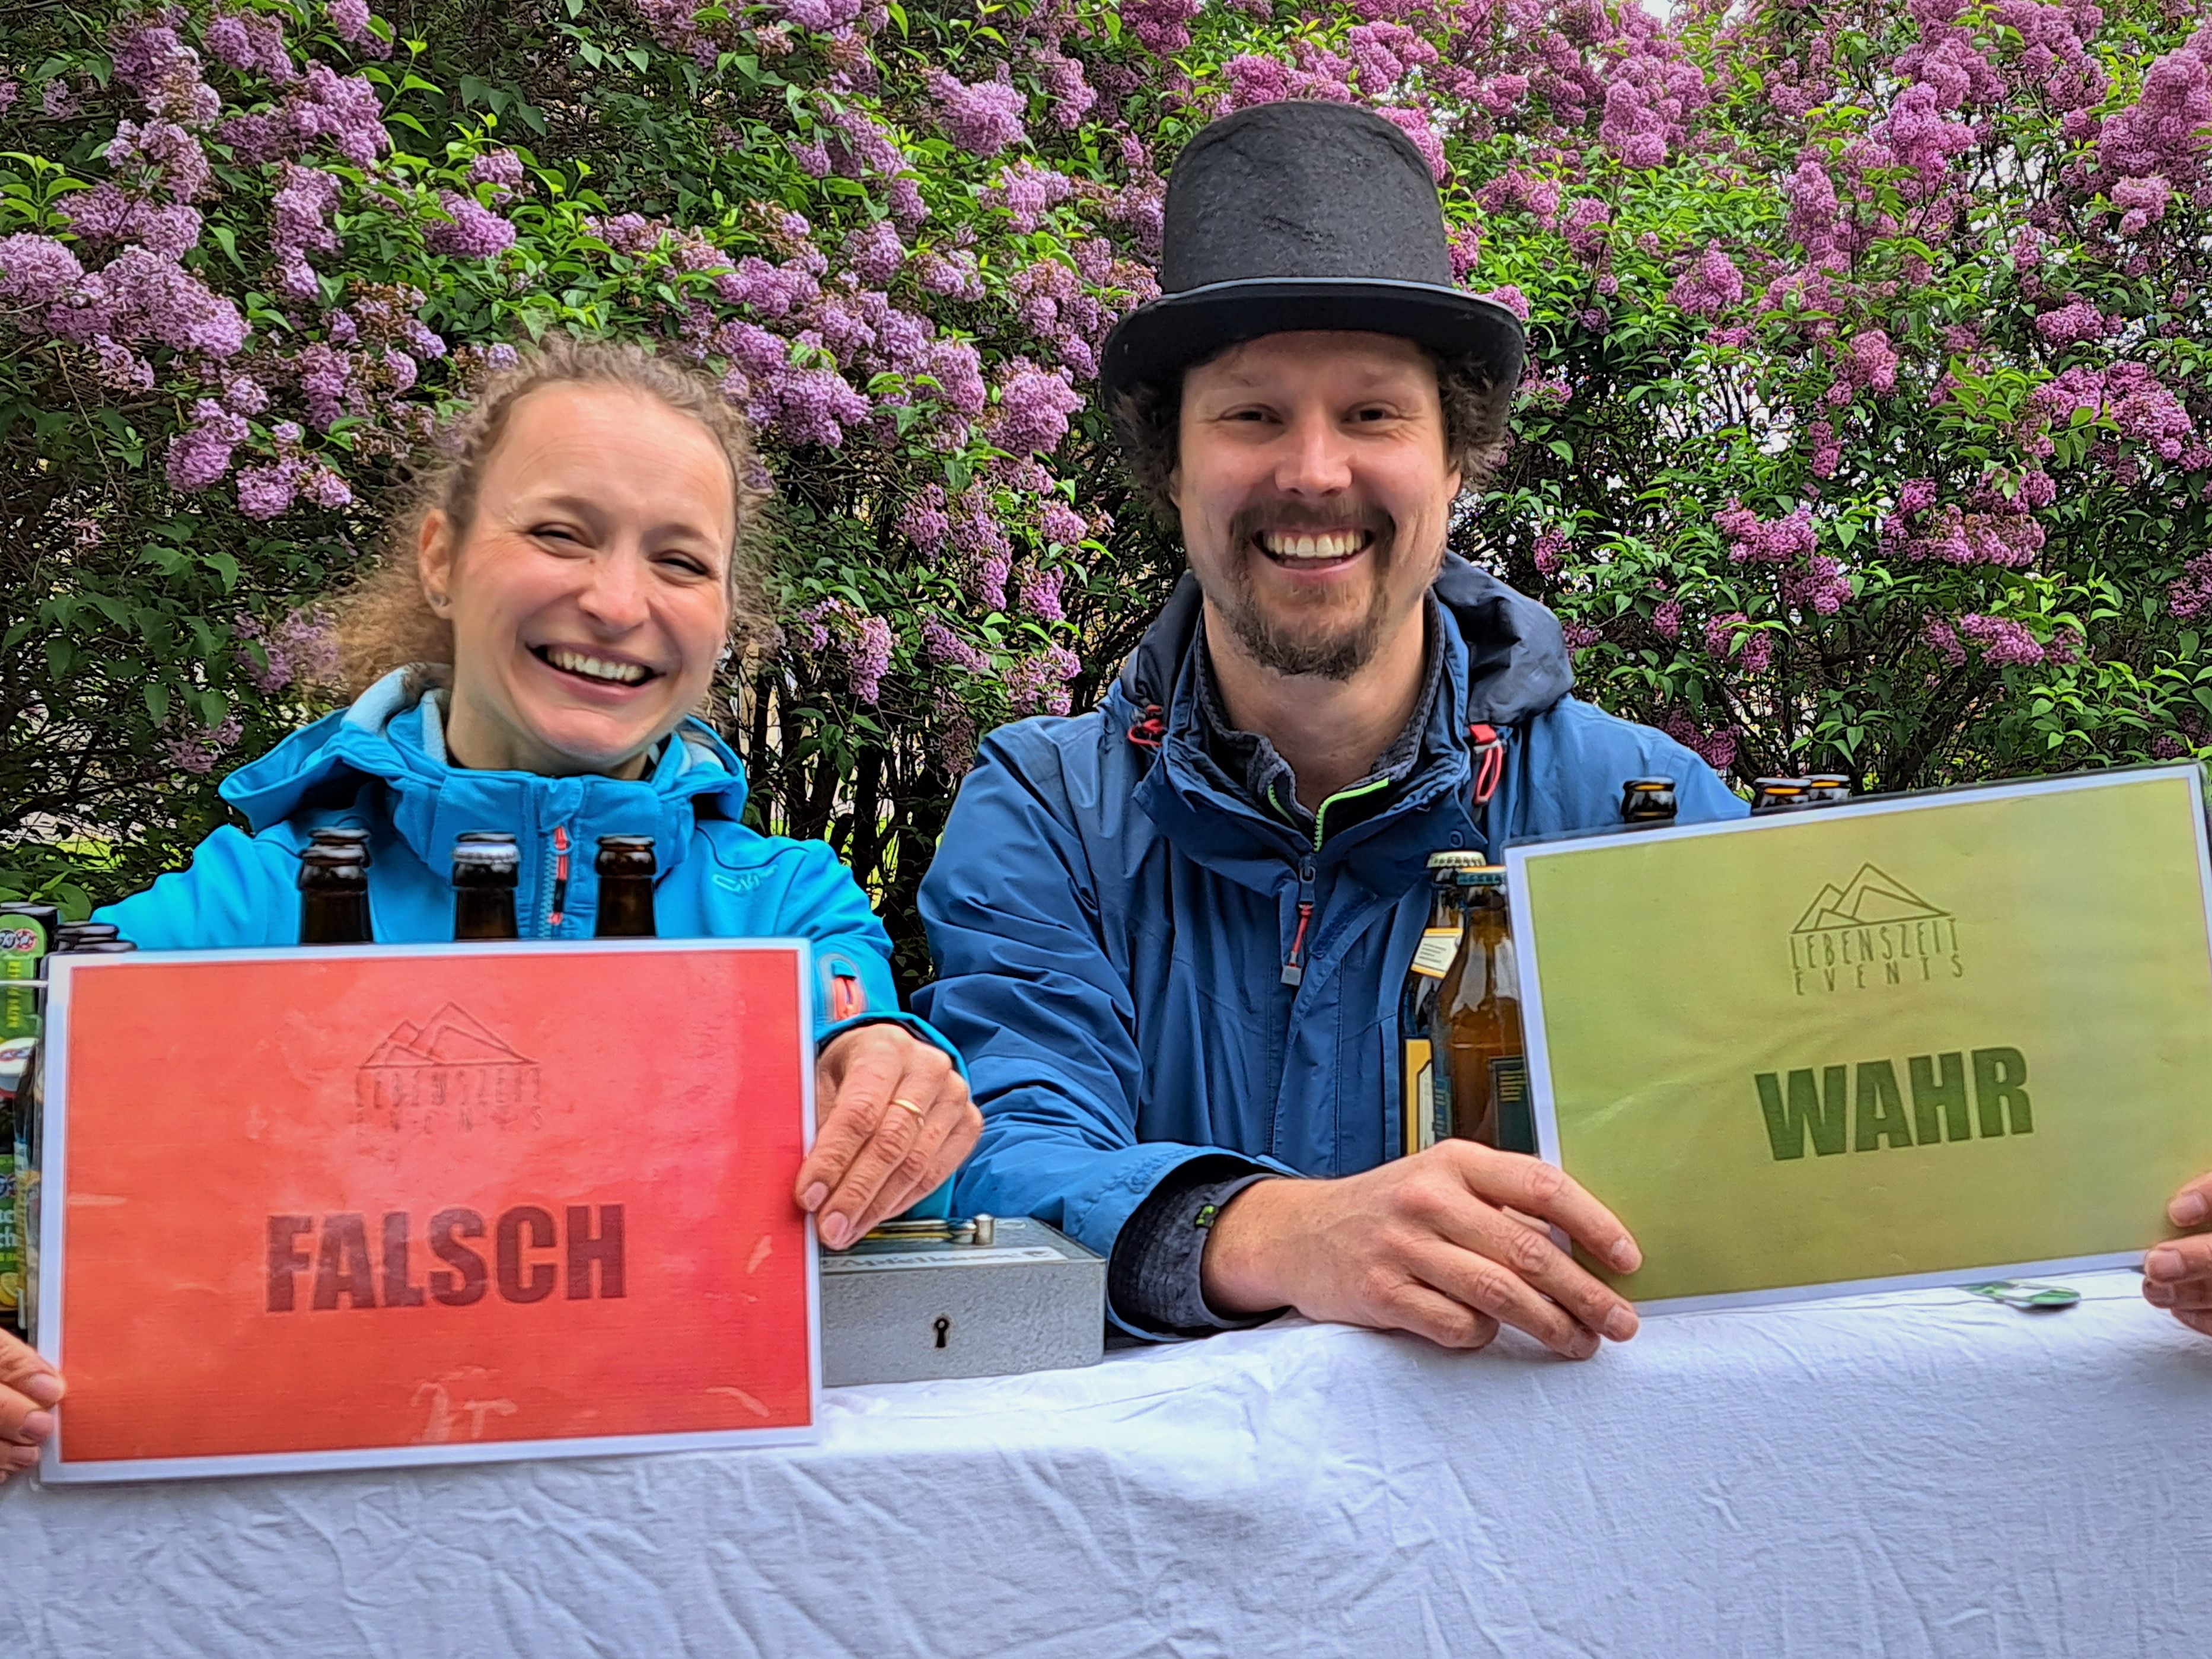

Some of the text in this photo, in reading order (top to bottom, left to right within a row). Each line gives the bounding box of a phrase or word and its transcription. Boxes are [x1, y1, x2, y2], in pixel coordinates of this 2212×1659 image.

[1790, 919, 1959, 970] LEBENSZEIT
[1795, 954, 1963, 995] EVENTS
[1754, 1047, 2033, 1161] WAHR
[266, 1204, 626, 1313] FALSCH
